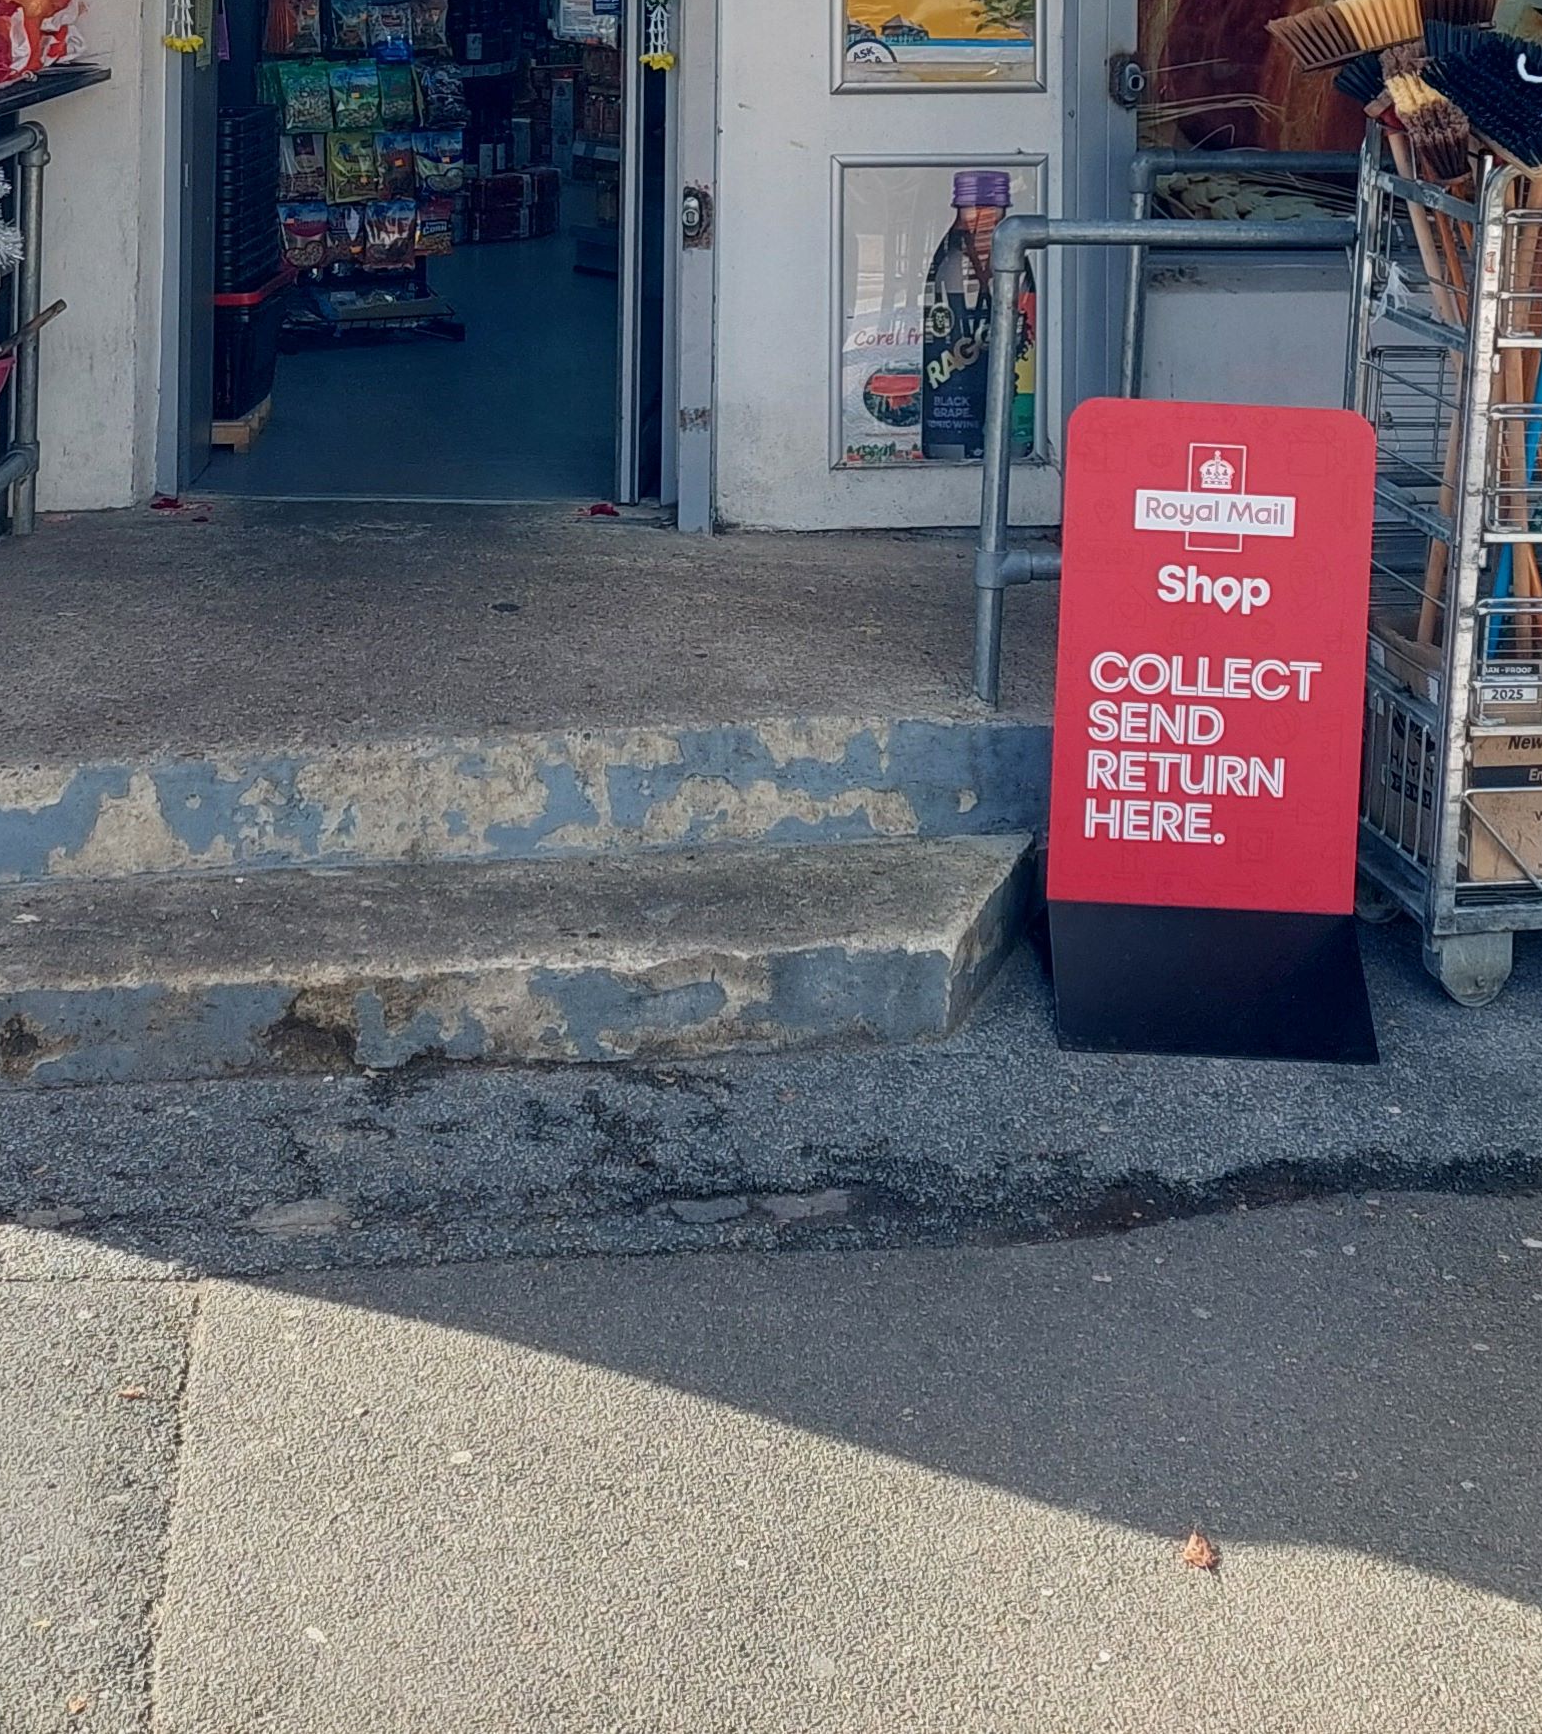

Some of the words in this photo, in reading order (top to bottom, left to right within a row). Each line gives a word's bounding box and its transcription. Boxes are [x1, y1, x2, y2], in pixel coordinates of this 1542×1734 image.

[853, 47, 876, 62] ASK
[933, 396, 971, 408] BLACK
[933, 407, 972, 419] GRAPE
[1144, 496, 1220, 526] Royal
[1226, 499, 1286, 527] Mail
[1157, 564, 1271, 616] Shop
[1089, 651, 1322, 703] COLLECT
[1491, 689, 1524, 701] 2025
[1088, 700, 1225, 746] SEND
[1086, 749, 1286, 799] RETURN
[1084, 798, 1226, 846] HERE.
